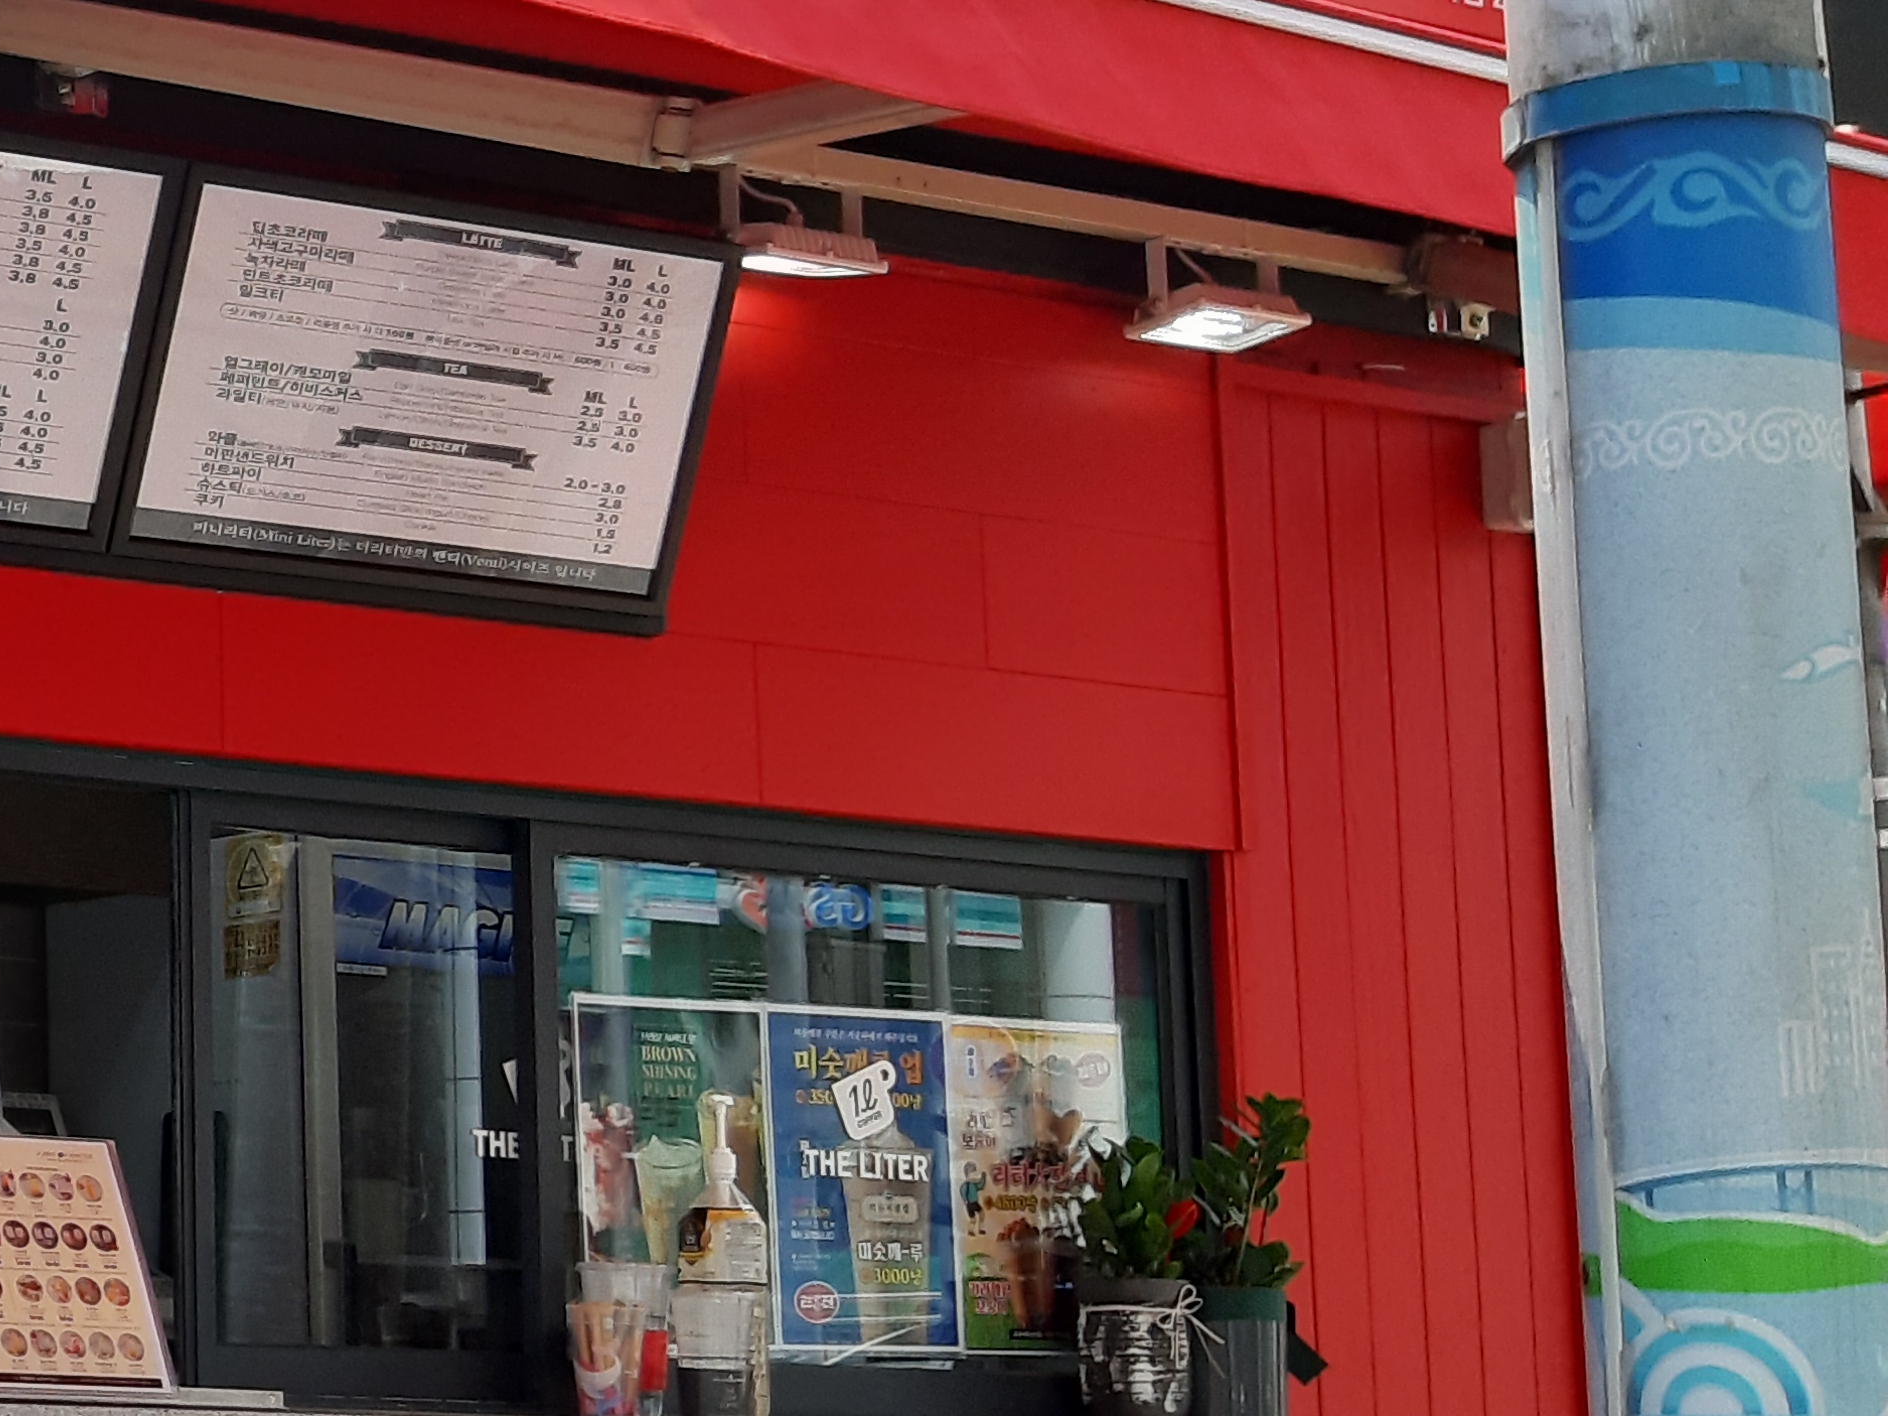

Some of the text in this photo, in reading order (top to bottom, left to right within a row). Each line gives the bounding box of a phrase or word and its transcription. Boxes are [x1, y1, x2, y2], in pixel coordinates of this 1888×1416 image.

[640, 1044, 698, 1064] BROWN
[471, 1128, 520, 1161] THE
[804, 1148, 930, 1183] THE LITER
